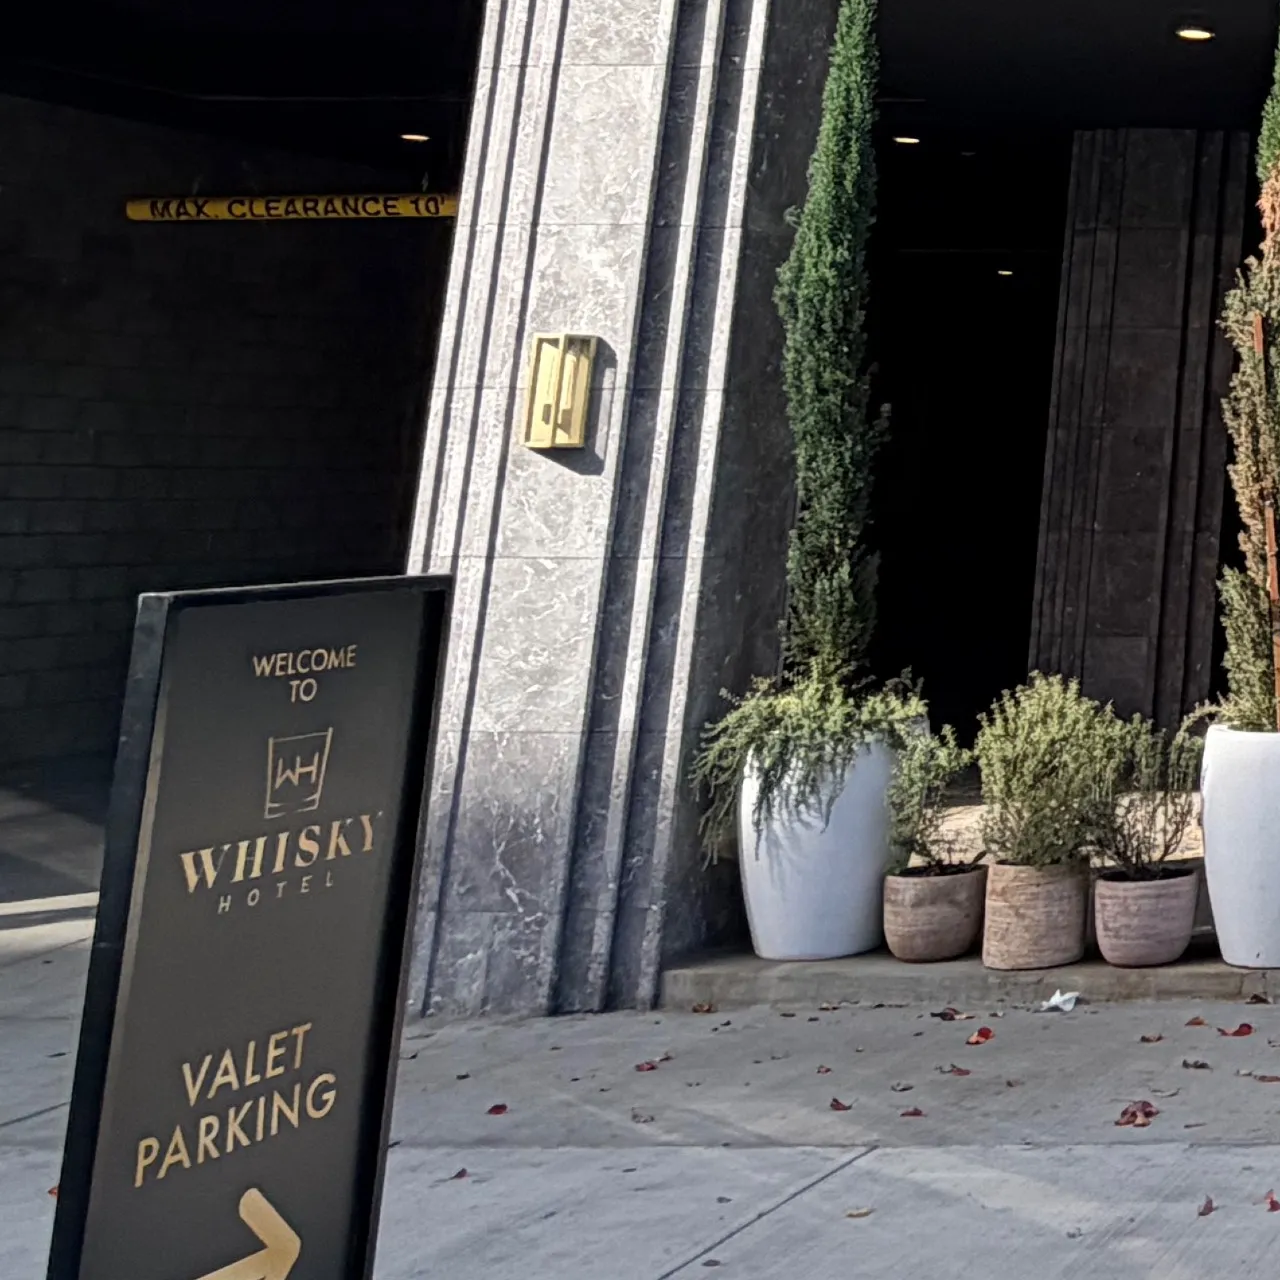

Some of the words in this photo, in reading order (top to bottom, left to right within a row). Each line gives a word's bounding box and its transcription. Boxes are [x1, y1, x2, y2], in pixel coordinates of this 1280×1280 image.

[150, 197, 219, 219] MAX.
[227, 195, 401, 218] CLEARANCE
[252, 644, 358, 677] WELCOME
[289, 678, 318, 703] TO
[179, 810, 384, 894] WHISKY
[217, 871, 334, 915] HOTEL
[181, 1022, 313, 1108] VALET
[133, 1073, 337, 1189] PARKING
